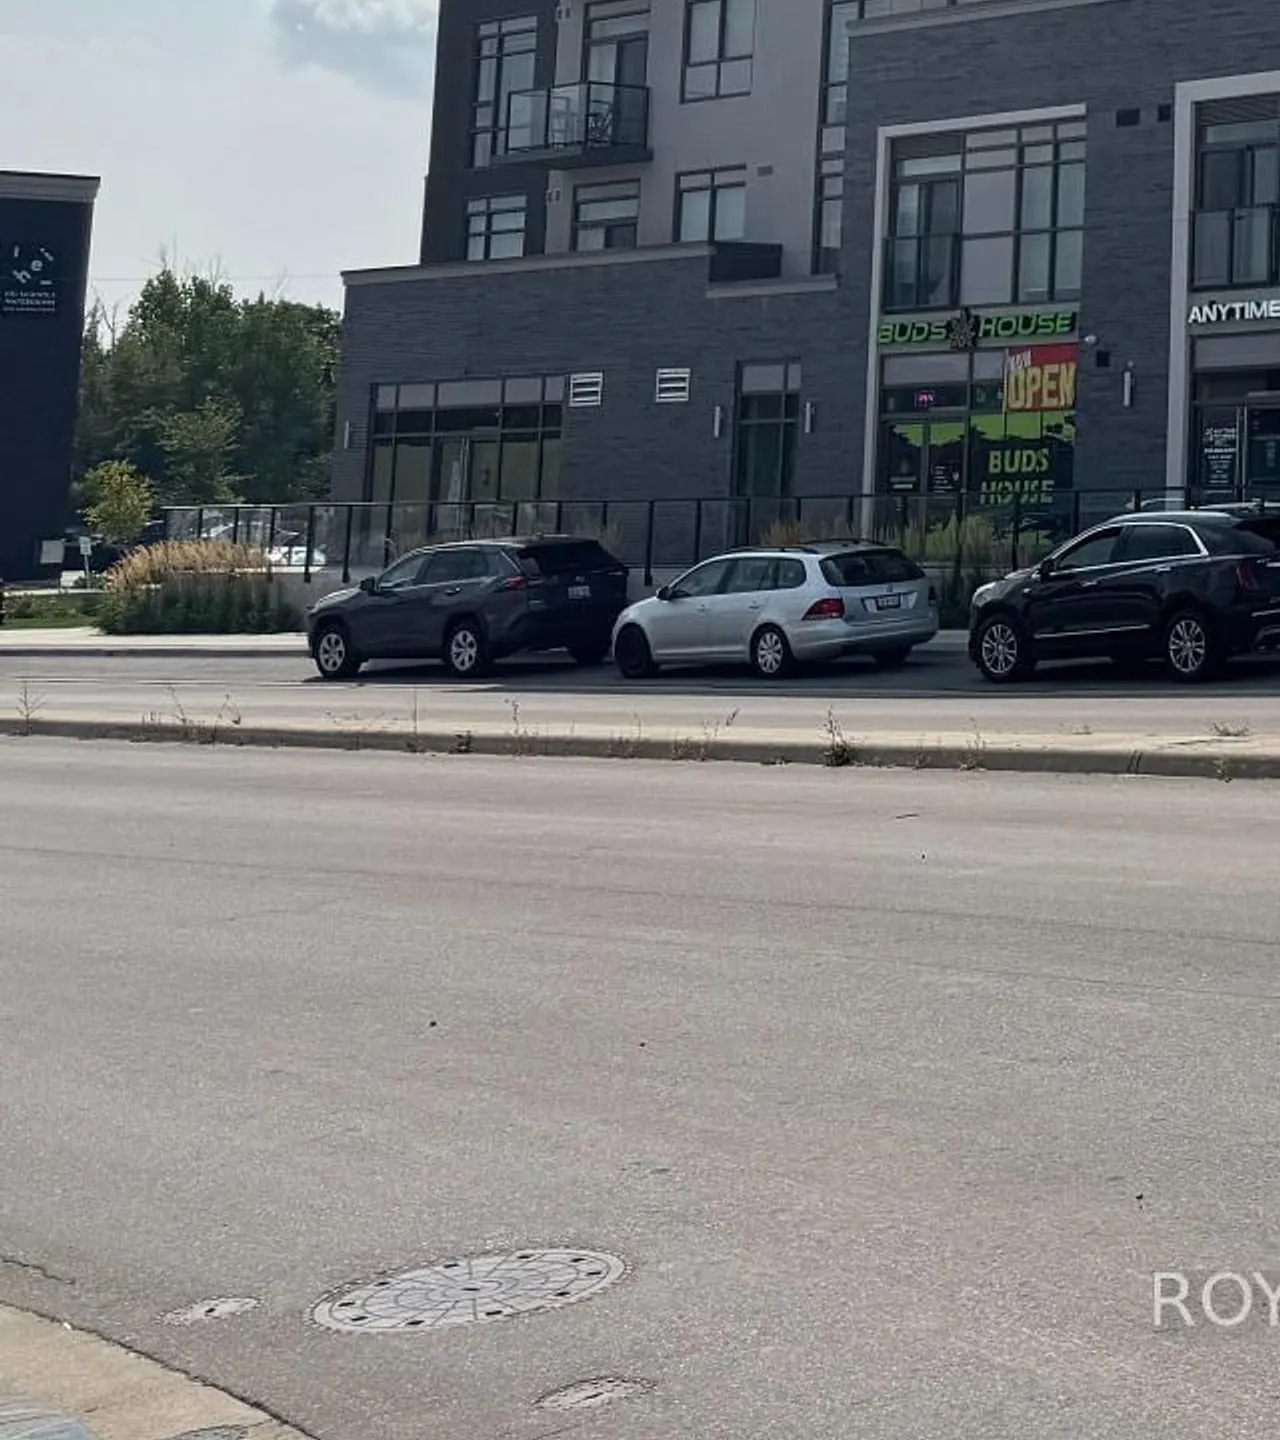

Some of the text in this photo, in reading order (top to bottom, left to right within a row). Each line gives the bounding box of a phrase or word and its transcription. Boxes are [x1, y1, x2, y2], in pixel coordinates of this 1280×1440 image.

[878, 312, 1074, 344] BUDS HOUSE
[1009, 362, 1076, 409] OPEN
[988, 448, 1050, 473] BUDS
[980, 479, 1056, 505] HOUSE
